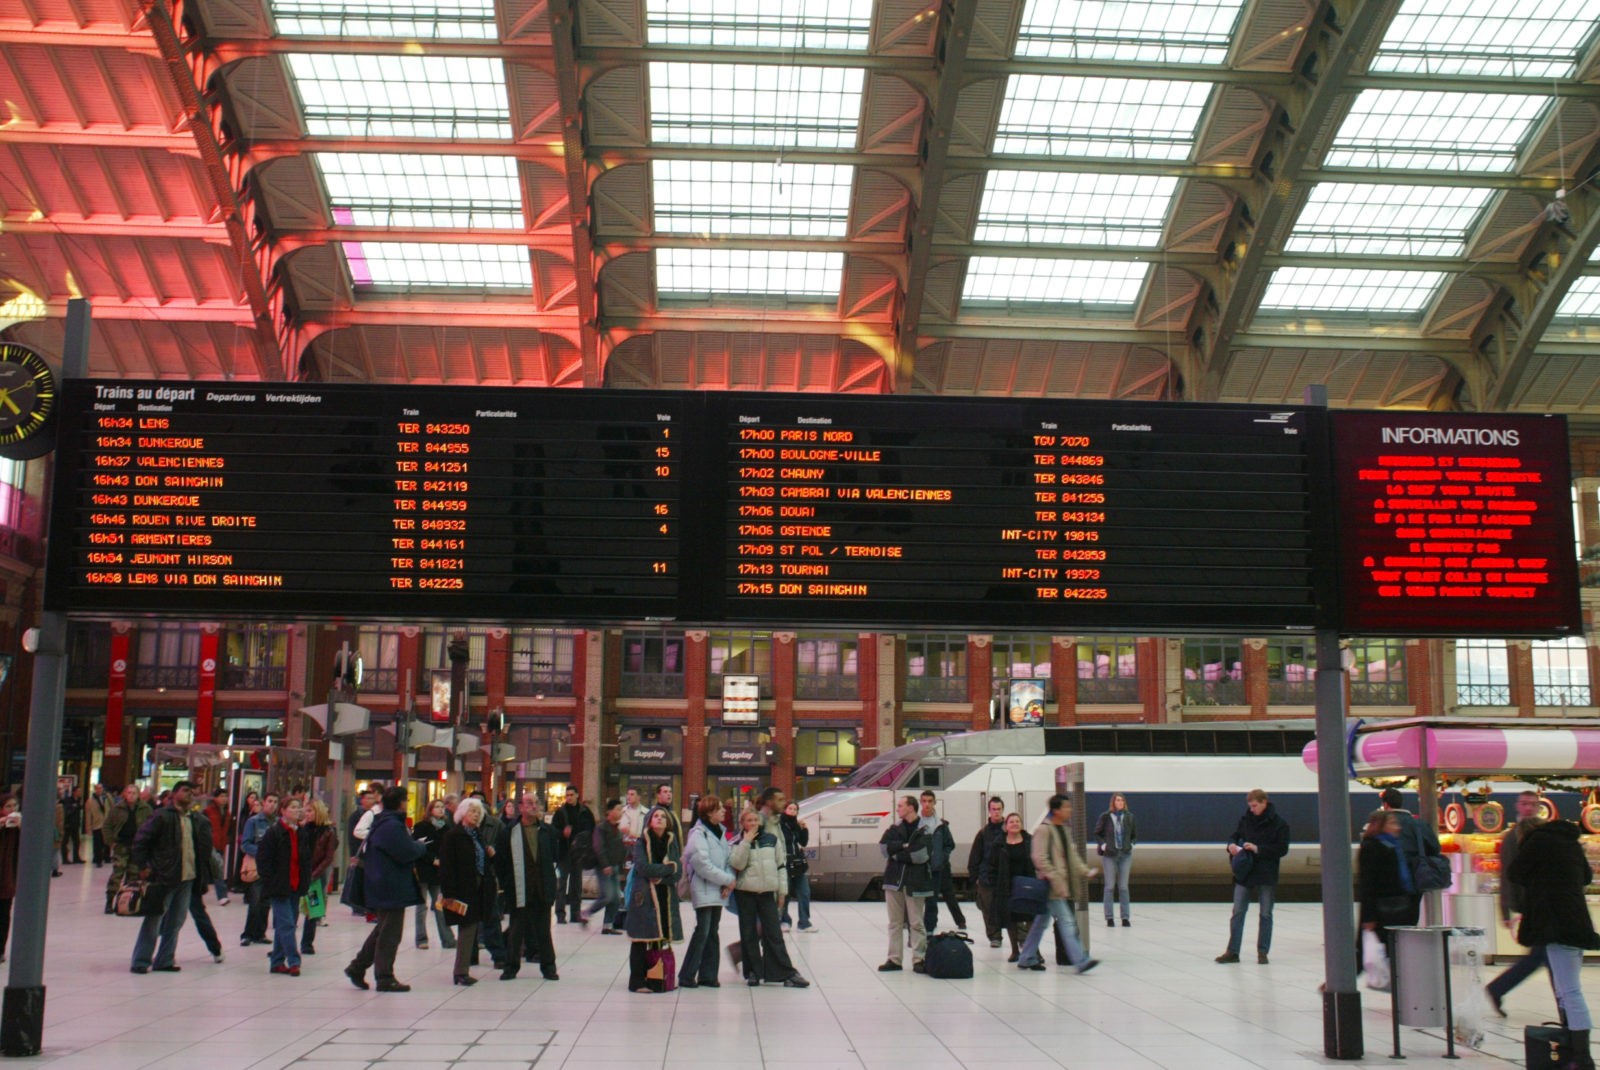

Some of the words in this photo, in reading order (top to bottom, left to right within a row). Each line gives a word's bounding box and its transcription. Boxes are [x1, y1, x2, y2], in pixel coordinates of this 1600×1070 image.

[95, 386, 134, 400] Trains
[136, 388, 152, 400] au
[154, 387, 196, 403] départ
[206, 392, 256, 403] Departures
[265, 393, 322, 405] Vertrektijden
[98, 417, 134, 429] 16h34
[138, 417, 170, 430] LENS
[397, 422, 421, 434] TER
[425, 423, 471, 435] 843250
[663, 428, 670, 439] 1
[1381, 426, 1520, 447] INFORMATIONS
[739, 428, 776, 441] 17h00
[780, 429, 818, 442] PARIS
[822, 430, 854, 443] NORD
[1033, 435, 1056, 447] TGV
[96, 436, 133, 448] 16h34
[397, 441, 420, 453] TER
[425, 442, 470, 454] 844955
[655, 446, 671, 458] 15
[739, 447, 776, 460] 17h00
[779, 448, 881, 462] BOULOGNE-VILLE
[1033, 454, 1057, 466] TER
[95, 455, 131, 467] 16h37
[136, 456, 225, 469] VALENCIENNES
[395, 460, 419, 472] TER
[424, 461, 468, 473] 841251
[655, 465, 670, 477] 10
[93, 474, 130, 487] 16h43
[134, 475, 159, 487] DON
[163, 475, 224, 488] SAINGHIN
[394, 479, 418, 492] TER
[423, 480, 469, 492] 842119
[738, 467, 776, 479] 17h02
[780, 467, 825, 480] CHAUNY
[1034, 472, 1057, 484] TER
[738, 485, 776, 498] 17h03
[780, 486, 831, 499] CAMBRAI
[837, 487, 861, 499] VIA
[865, 487, 953, 501] VALENCIENNES
[1034, 491, 1057, 503] TER
[1061, 492, 1106, 504] 841255
[91, 493, 129, 506] 16h43
[393, 498, 417, 511] TER
[421, 499, 468, 512] 844959
[654, 503, 669, 515] 16
[738, 505, 775, 517] 17h06
[779, 505, 816, 518] DOUAI
[1034, 510, 1057, 522] TER
[1061, 511, 1106, 523] 843134
[90, 513, 127, 526] 16h46
[131, 514, 171, 526] ROUEN
[175, 514, 206, 527] RIVE
[211, 515, 257, 528] DROITE
[393, 518, 416, 530] TER
[659, 523, 668, 535] 4
[738, 524, 775, 537] 17h06
[779, 525, 832, 537] OSTENDE
[1001, 529, 1058, 541] INT-CITY
[1064, 530, 1100, 542] 19815
[89, 532, 125, 545] 16h51
[130, 533, 213, 547] ARMENTIERES
[392, 537, 415, 550] TER
[420, 538, 465, 550] 844161
[737, 543, 775, 556] 17h09
[779, 544, 796, 556] ST
[800, 544, 824, 557] POL
[844, 545, 903, 558] TERNOISE
[1035, 548, 1059, 560] TER
[87, 552, 124, 564] 16h54
[129, 552, 182, 565] JEUMONT
[187, 554, 233, 566] HIRSON
[391, 557, 414, 569] TER
[419, 558, 464, 570] 841821
[652, 562, 667, 573] 11
[737, 563, 775, 575] 17h13
[779, 563, 830, 576] TOURNAI
[1002, 567, 1059, 579] INT-CITY
[85, 572, 123, 584] 16h58
[127, 572, 159, 585] LENS
[164, 573, 189, 585] VIA
[193, 573, 218, 585] DON
[222, 574, 283, 587] SAINGHIN
[389, 577, 413, 589] TER
[418, 577, 465, 590] 842225
[737, 582, 775, 595] 17h15
[778, 583, 803, 595] DON
[807, 583, 868, 596] SAINGHIN
[1036, 587, 1059, 599] TER
[1063, 587, 1108, 600] 842235
[633, 749, 666, 759] Supplay
[721, 750, 754, 761] Supplay
